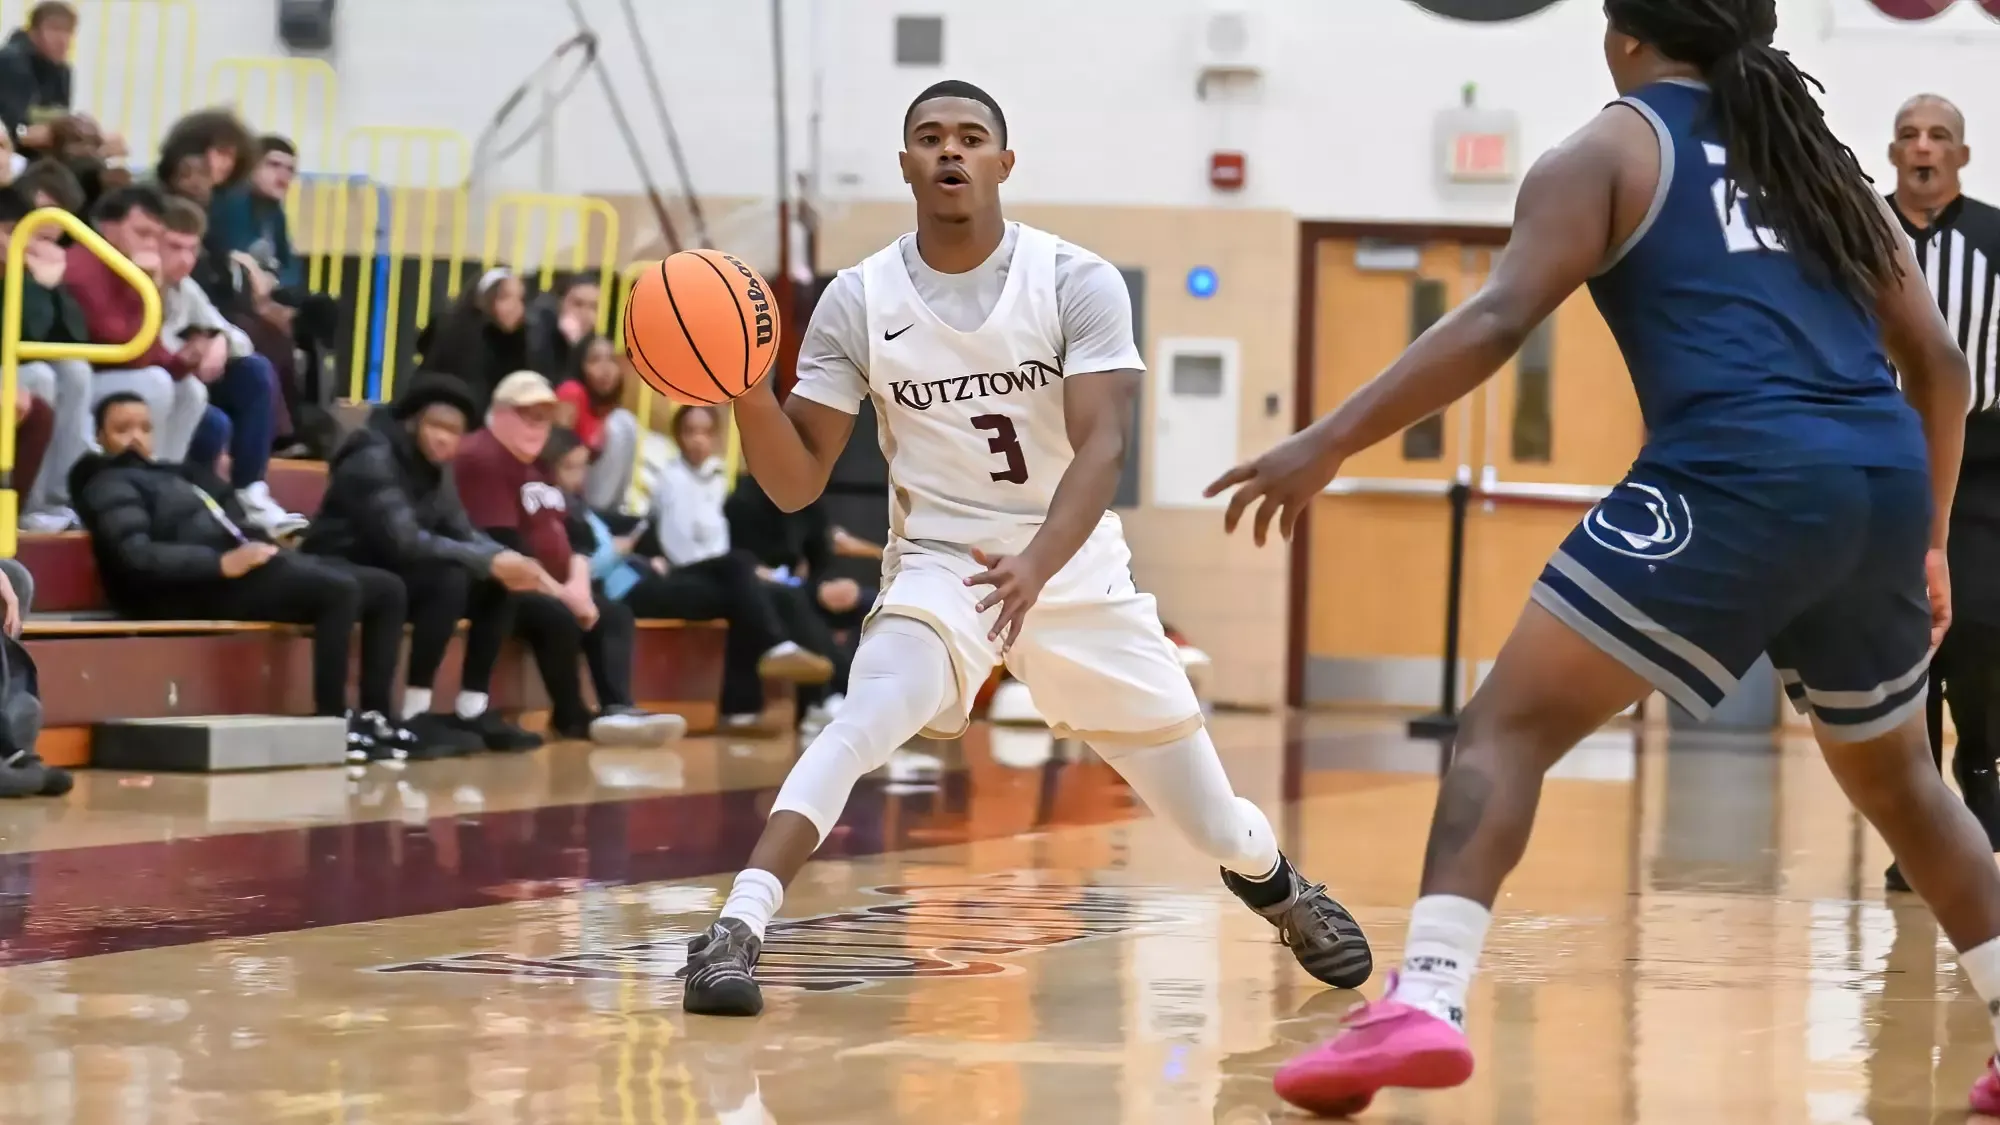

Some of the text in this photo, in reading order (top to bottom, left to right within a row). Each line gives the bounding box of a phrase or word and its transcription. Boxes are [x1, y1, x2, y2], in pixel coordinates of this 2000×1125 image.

[723, 255, 773, 348] Wilson
[888, 356, 1064, 410] KUTZTOWN
[970, 413, 1028, 484] 3
